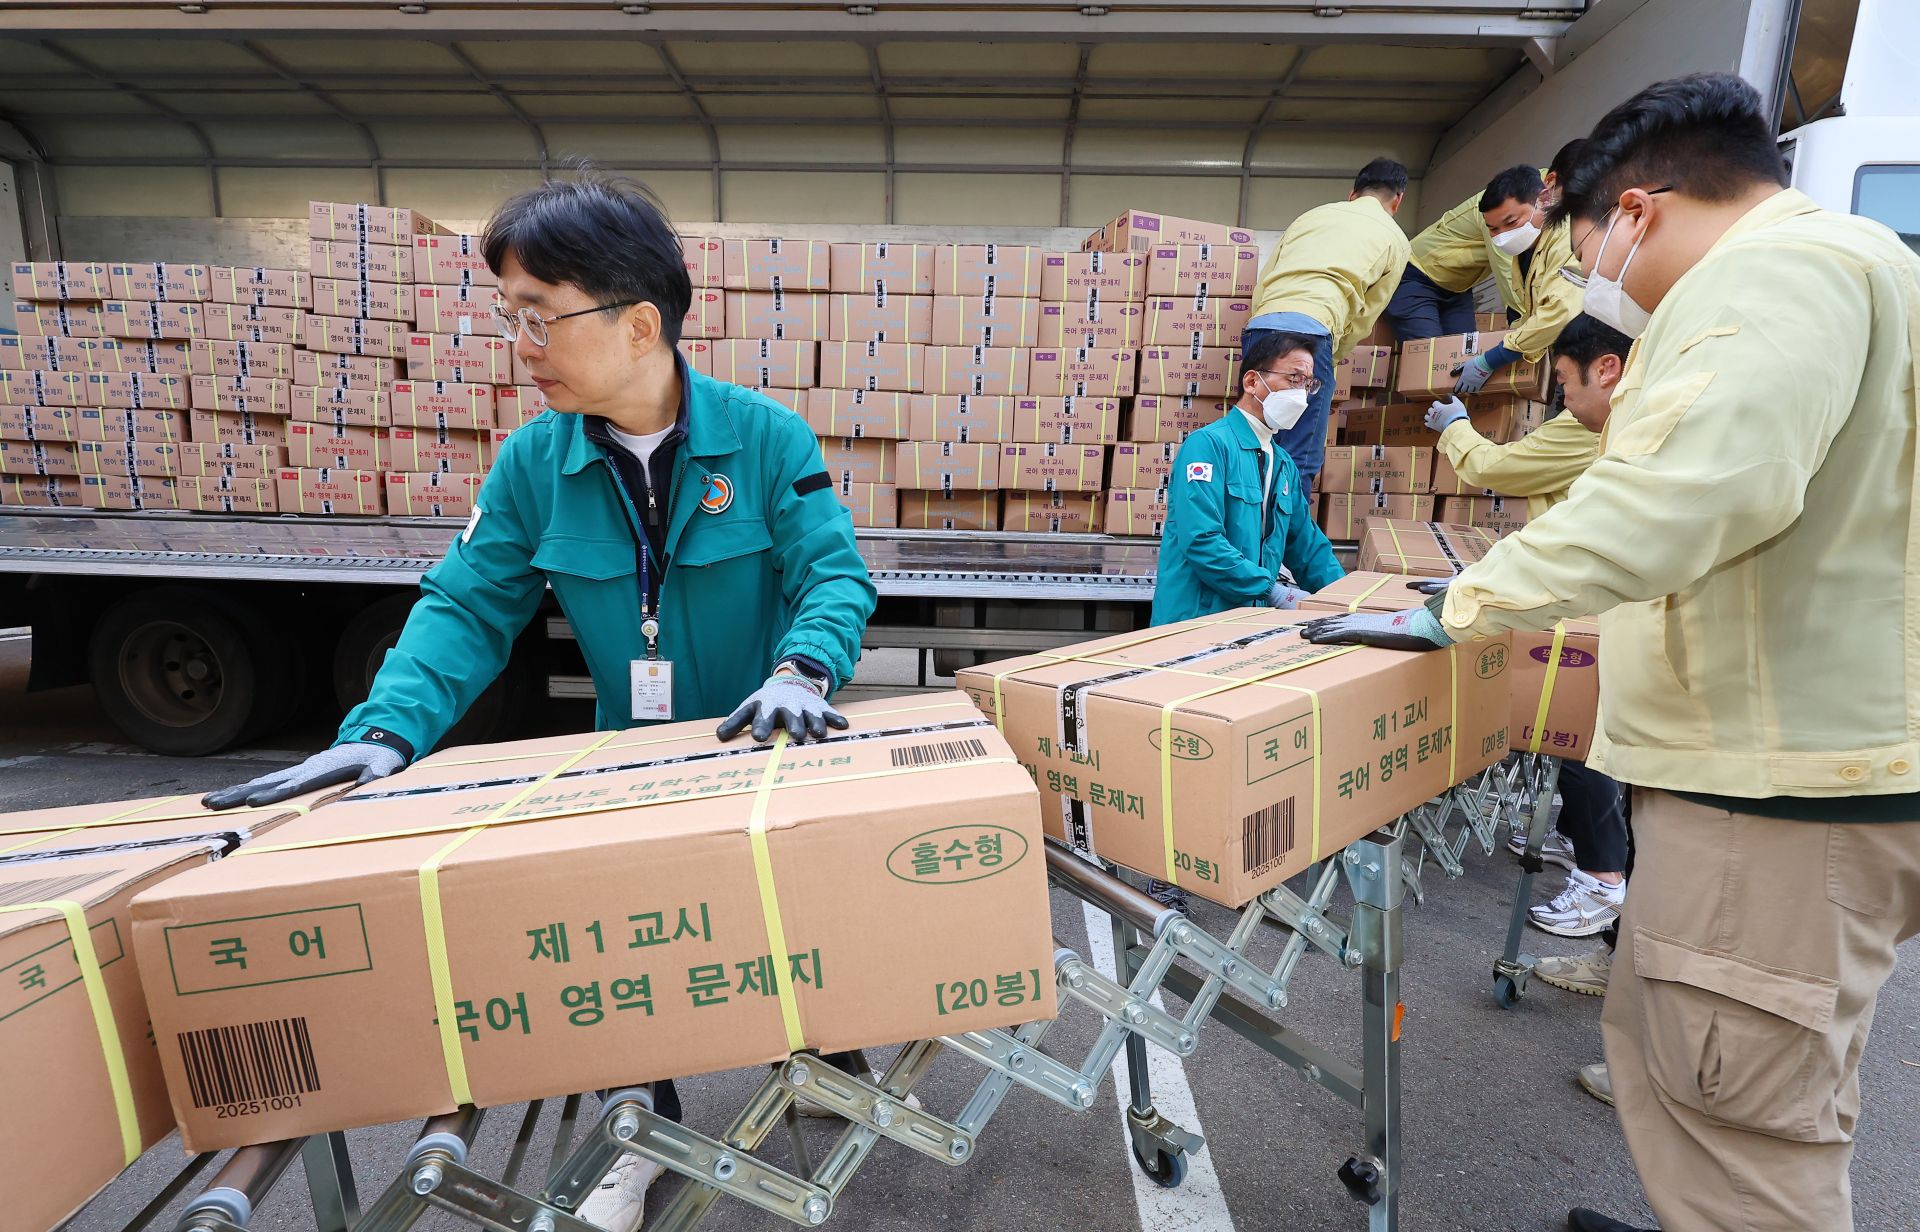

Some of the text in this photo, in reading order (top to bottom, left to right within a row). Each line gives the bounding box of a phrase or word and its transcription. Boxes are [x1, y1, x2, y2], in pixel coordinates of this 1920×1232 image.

[1372, 696, 1428, 740] 제 1 교시
[1038, 736, 1051, 758] 제
[1173, 735, 1200, 756] 수형
[1264, 727, 1307, 761] 국 어
[1338, 762, 1370, 799] 국어
[1380, 743, 1408, 783] 영역
[1047, 769, 1078, 798] 영역
[1089, 781, 1144, 820] 문제지
[911, 833, 1003, 876] 홀수형
[1251, 855, 1287, 880] 20251001
[208, 926, 326, 970] 국 어
[526, 902, 712, 964] 제 1 교시
[18, 963, 46, 991] 국
[560, 974, 654, 1027] 영역
[686, 948, 823, 1008] 문제지
[216, 1095, 303, 1119] 20251001
